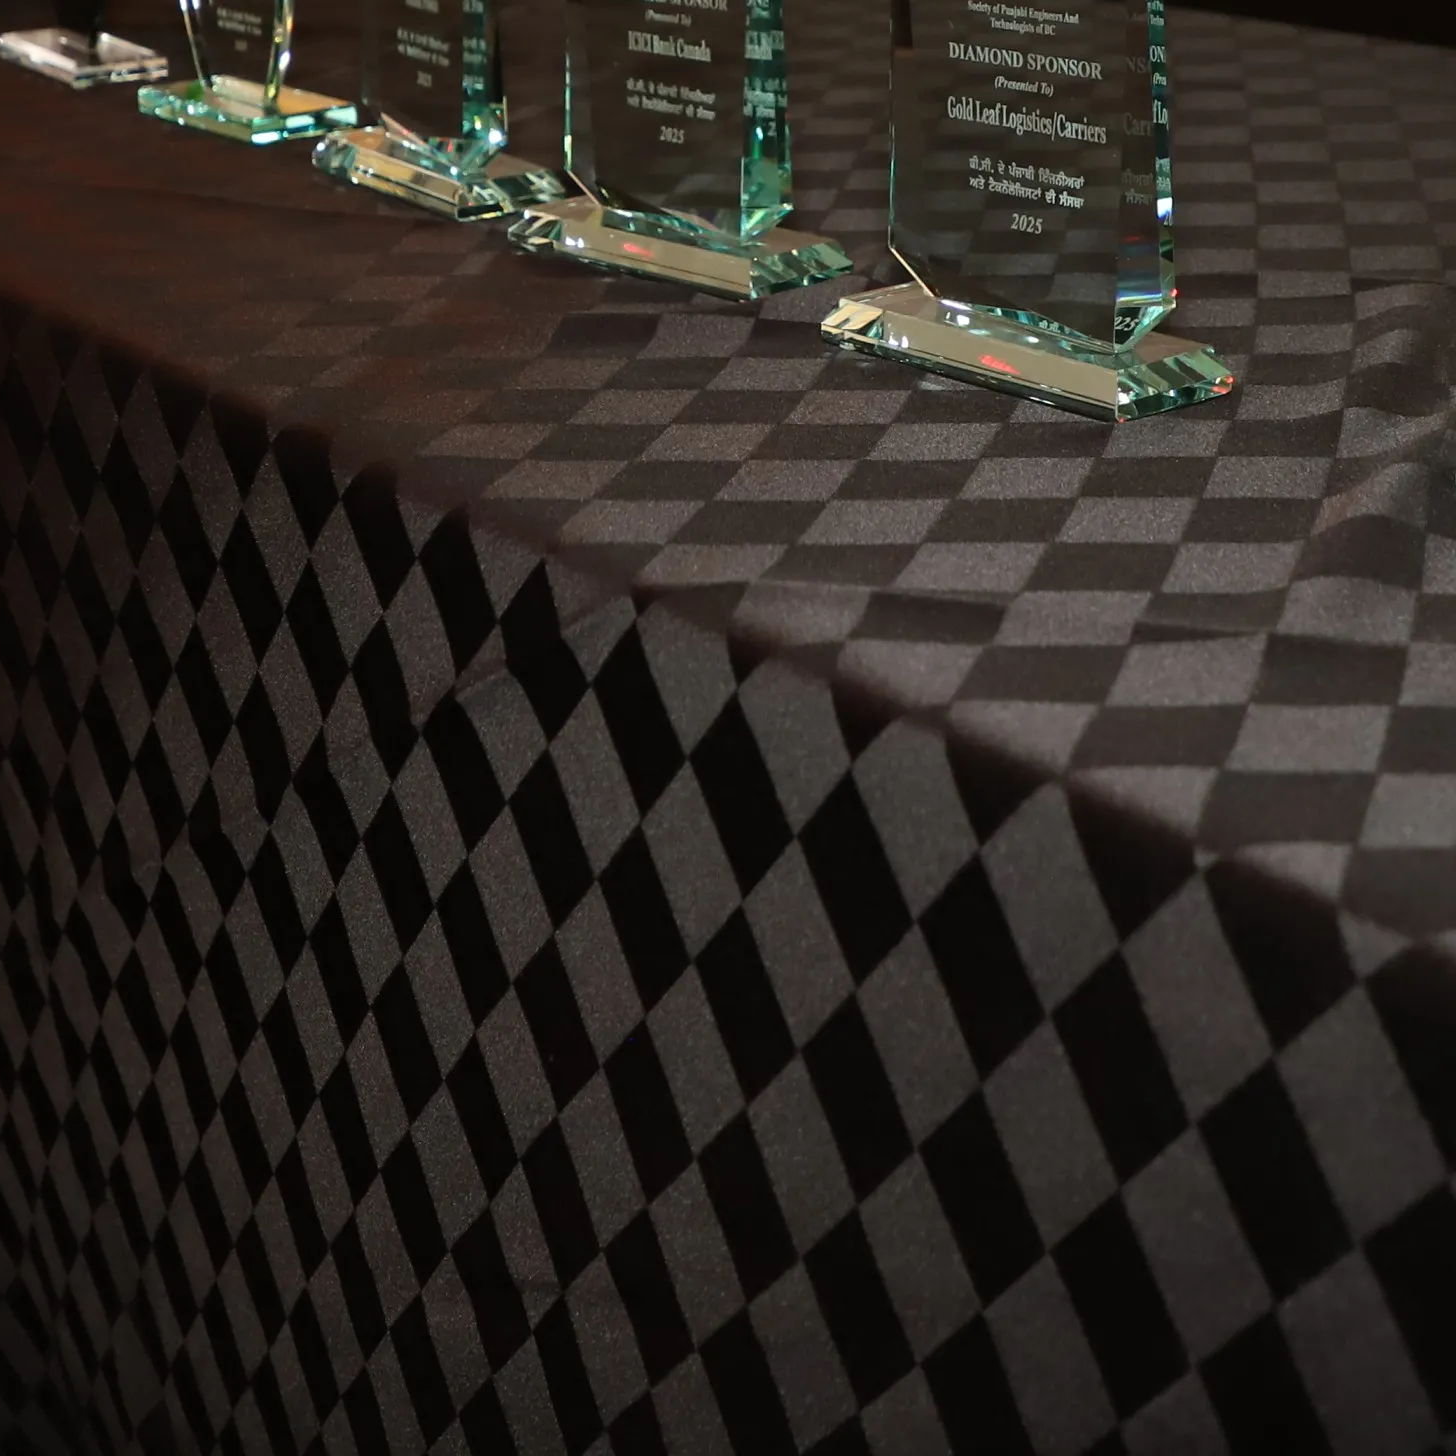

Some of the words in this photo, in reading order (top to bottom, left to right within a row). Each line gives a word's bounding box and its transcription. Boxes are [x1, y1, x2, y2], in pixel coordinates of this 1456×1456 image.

[967, 0, 991, 15] Society
[992, 3, 1000, 14] of
[1001, 5, 1027, 18] Punjabi
[1029, 8, 1062, 22] Engineers
[1063, 12, 1079, 24] And
[990, 17, 1034, 34] Technologists
[1036, 24, 1043, 34] of
[948, 42, 1024, 69] DIAMOND
[1027, 54, 1102, 80] SPONSOR
[994, 76, 1038, 93] (Presented
[1039, 82, 1054, 97] To)
[947, 96, 973, 122] Gold
[975, 103, 1001, 126] Leaf
[1002, 104, 1106, 144] Logistics/Carriers
[659, 126, 685, 144] 2025
[1010, 213, 1043, 234] 2025
